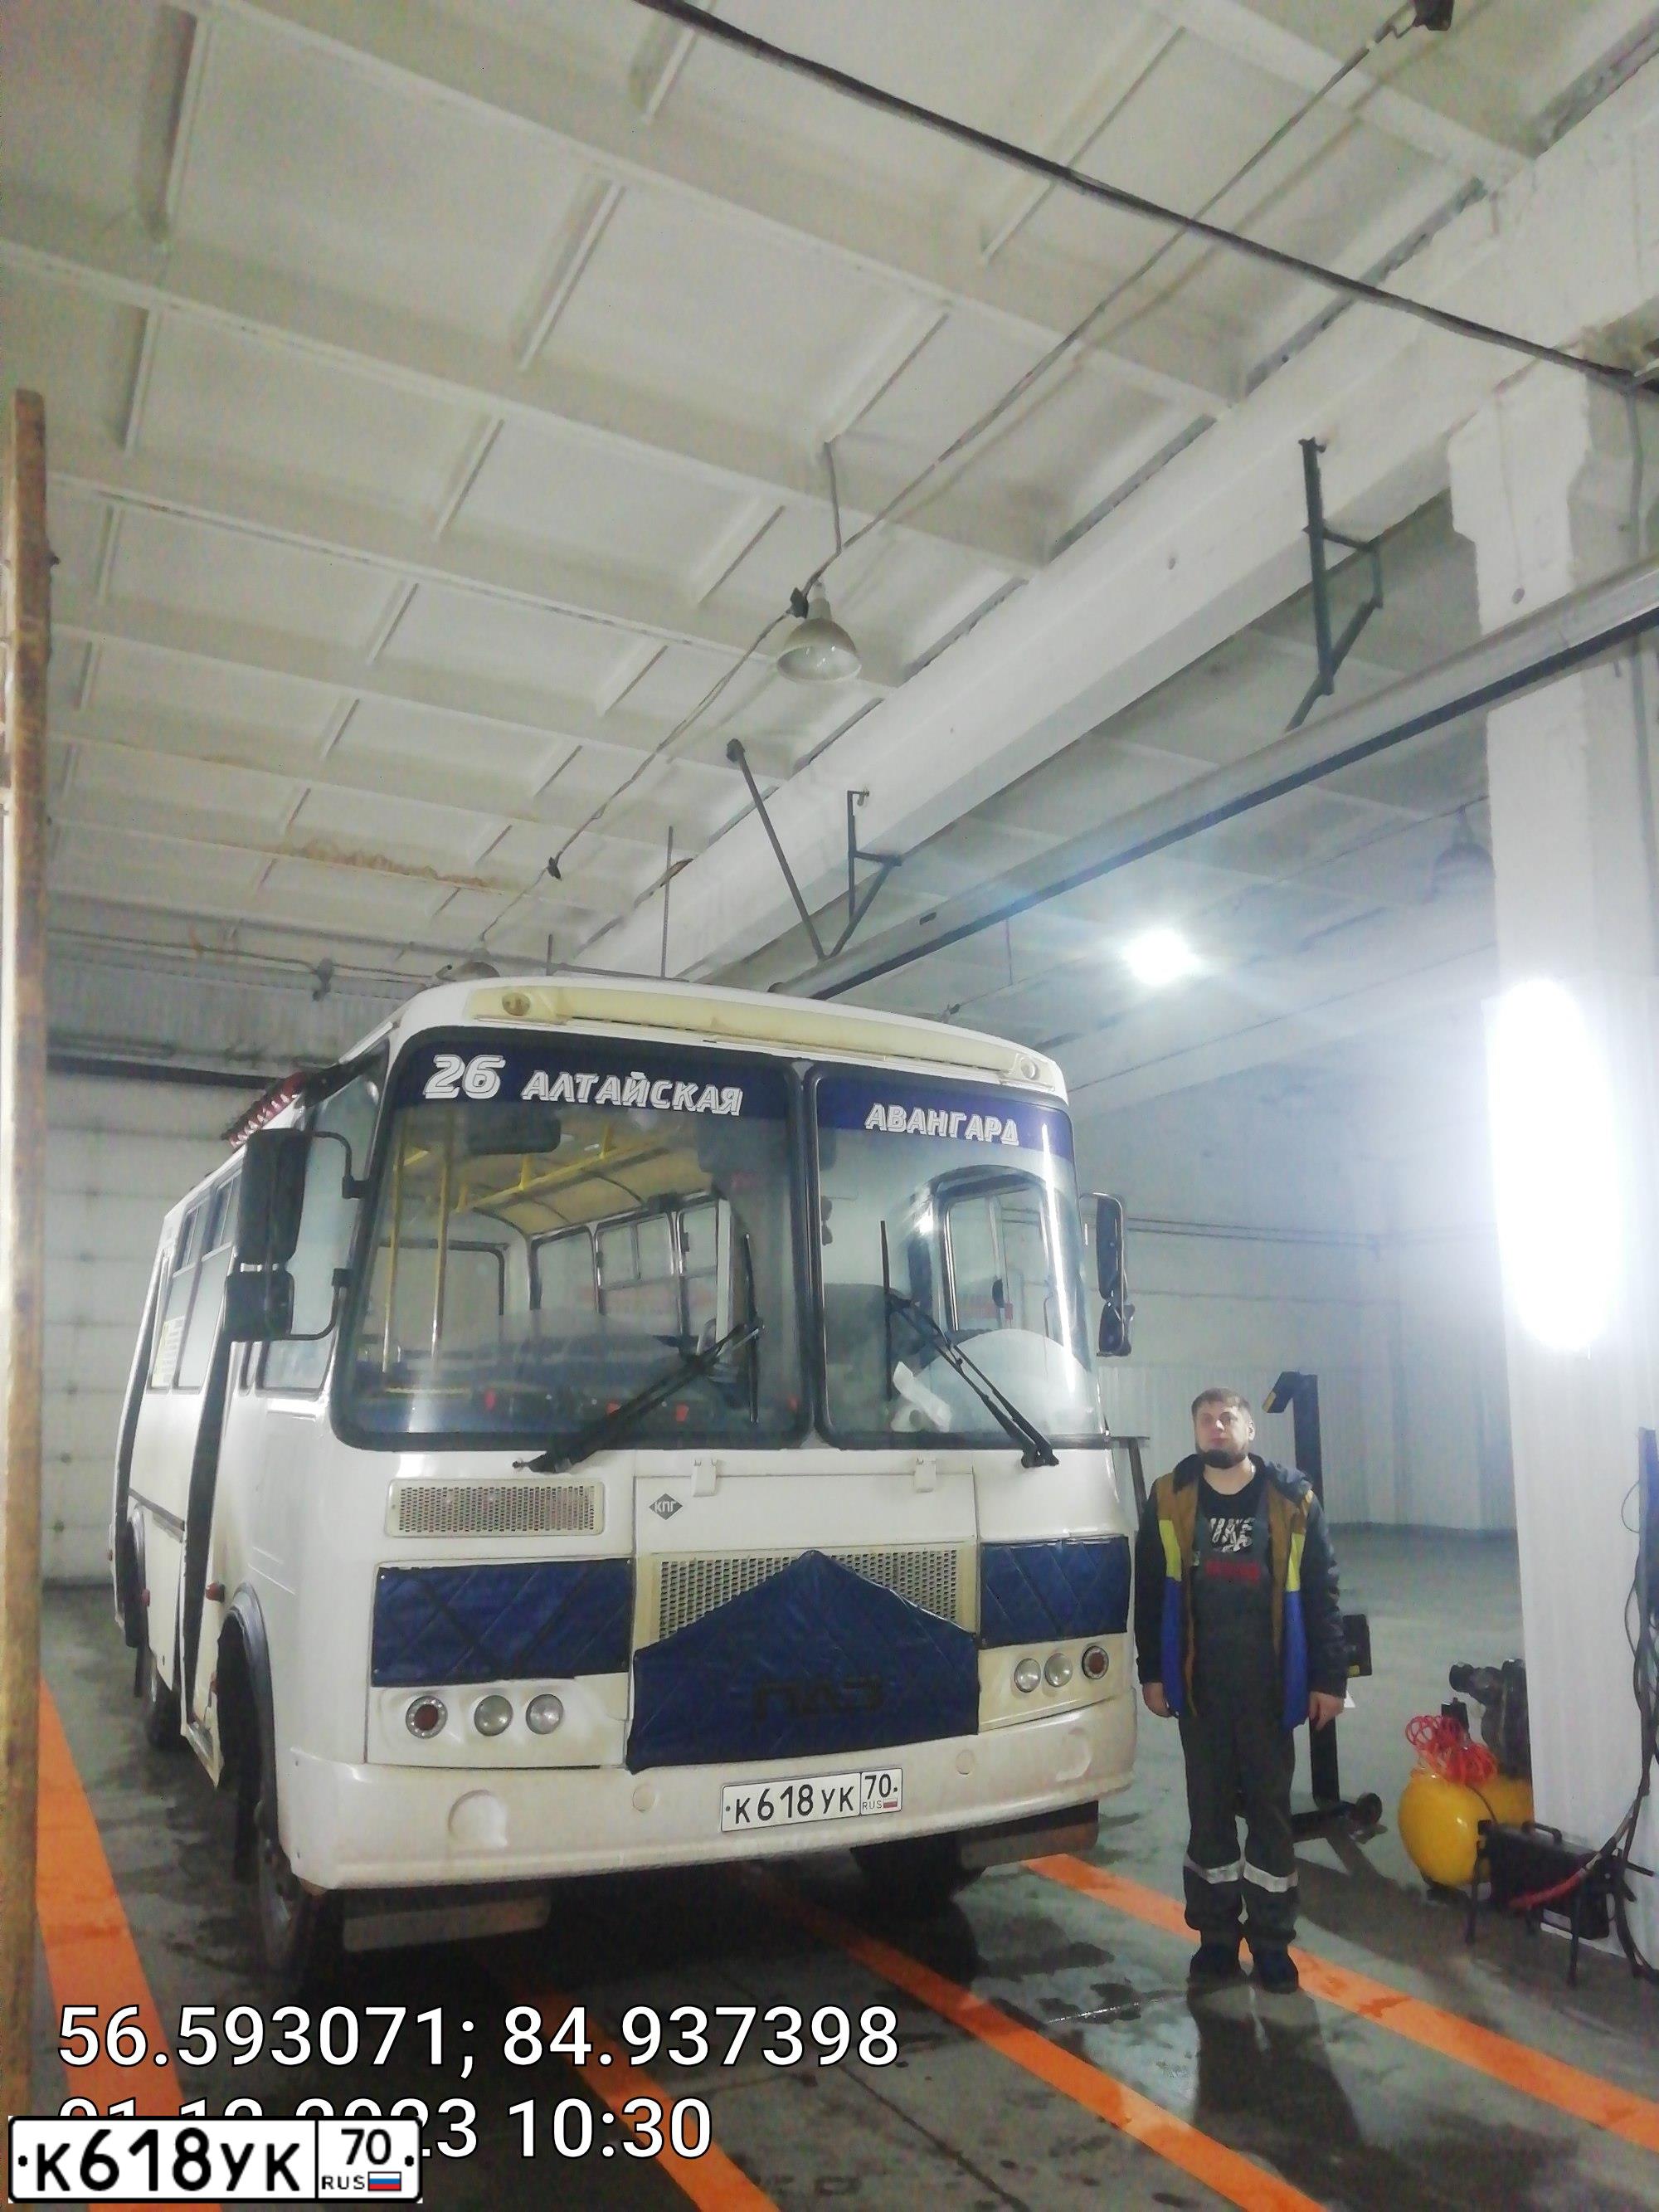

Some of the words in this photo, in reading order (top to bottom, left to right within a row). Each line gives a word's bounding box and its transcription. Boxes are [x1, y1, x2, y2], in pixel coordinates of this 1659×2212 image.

[423, 1055, 506, 1099] 26
[521, 1070, 743, 1116] АЛТАЙСКАЯ
[864, 1103, 1019, 1146] АВАНГАРД
[735, 1784, 854, 1825] К618УК
[864, 1773, 892, 1800] 70
[862, 1800, 883, 1810] RUS
